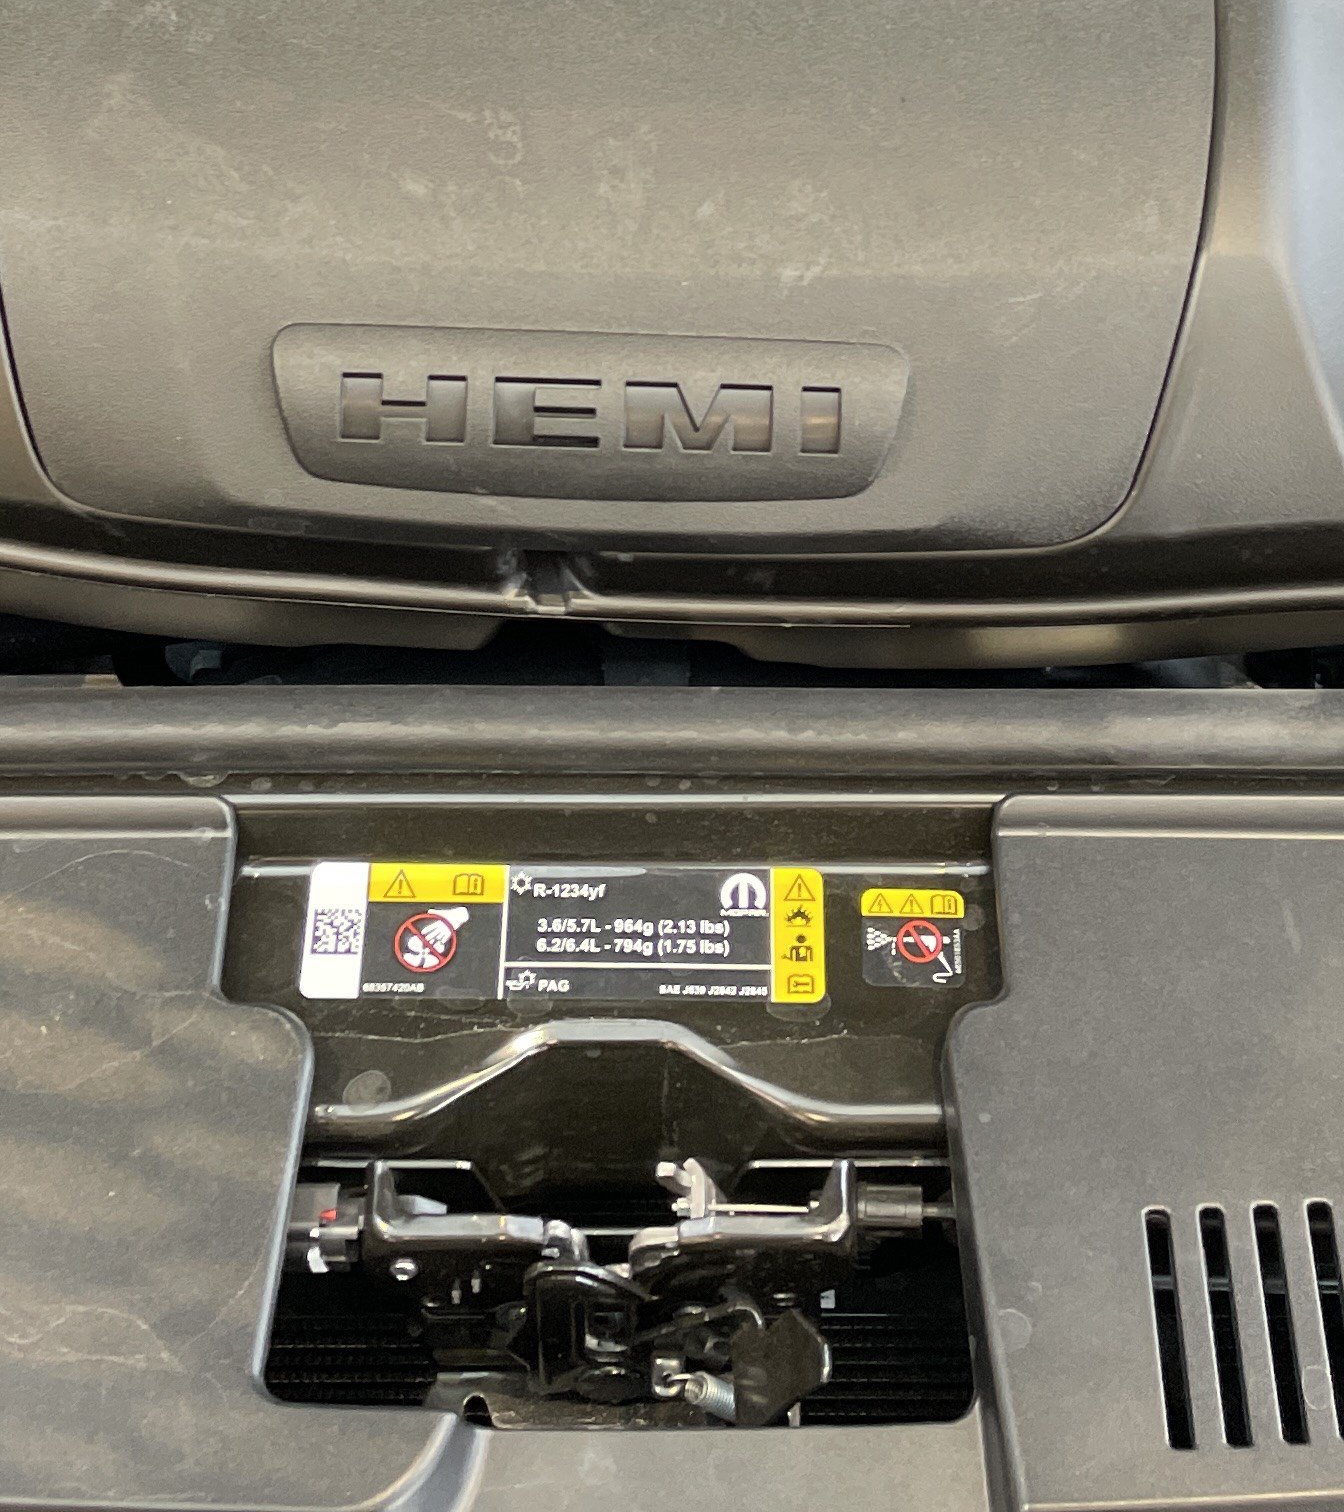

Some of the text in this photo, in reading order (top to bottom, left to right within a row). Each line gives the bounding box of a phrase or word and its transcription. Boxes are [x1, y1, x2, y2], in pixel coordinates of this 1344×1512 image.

[340, 372, 842, 454] HEMI
[533, 883, 607, 901] R-1234yf
[537, 918, 601, 934] 3.6/5.7L
[614, 919, 654, 936] 964g
[658, 918, 696, 936] (2.13
[700, 919, 730, 937] lbs)
[536, 938, 601, 954] 6.2/6.4L
[614, 939, 654, 956] 794g
[658, 939, 696, 957] (1.75
[700, 939, 730, 957] lbs)
[538, 979, 570, 992] PAG
